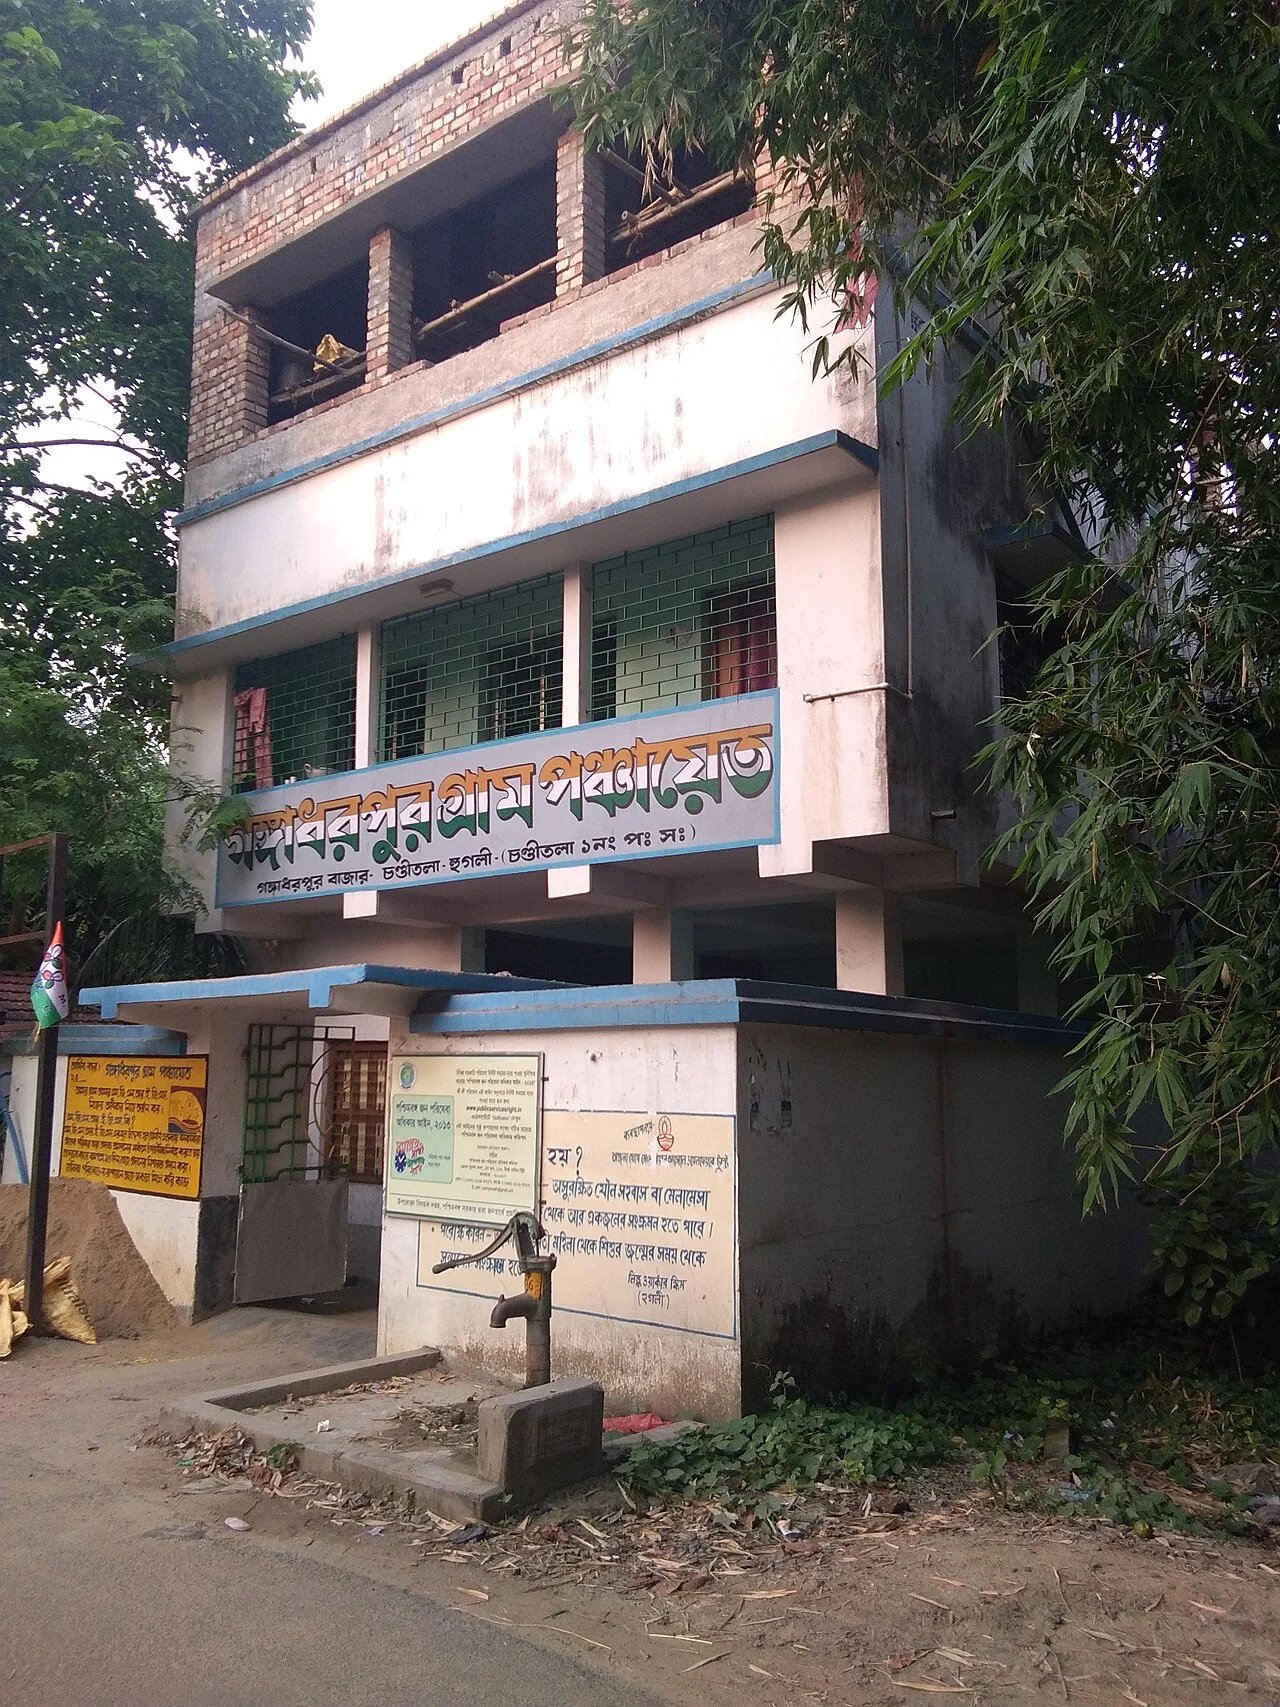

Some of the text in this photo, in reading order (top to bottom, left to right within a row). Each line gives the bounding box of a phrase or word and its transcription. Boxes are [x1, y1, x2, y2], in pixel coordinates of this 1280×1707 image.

[436, 762, 537, 838] গ্রাম
[538, 723, 774, 821] পঞ্চায়েত
[257, 874, 324, 896] গঙ্গাধরপুর
[547, 1147, 571, 1168] হয়
[552, 1176, 594, 1203] অসুরক্ষিত
[595, 1178, 618, 1201] যৌন
[618, 1184, 649, 1206] সহবাস
[651, 1186, 664, 1207] বা
[568, 1208, 587, 1228] আর
[587, 1210, 627, 1232] একজনের
[661, 1217, 682, 1234] হতে
[552, 1230, 577, 1257] মহিলা
[577, 1238, 598, 1256] থেকে
[598, 1235, 623, 1259] শিশুর
[625, 1242, 656, 1264] জন্মের
[657, 1246, 678, 1265] সময়
[680, 1248, 708, 1269] থেকে
